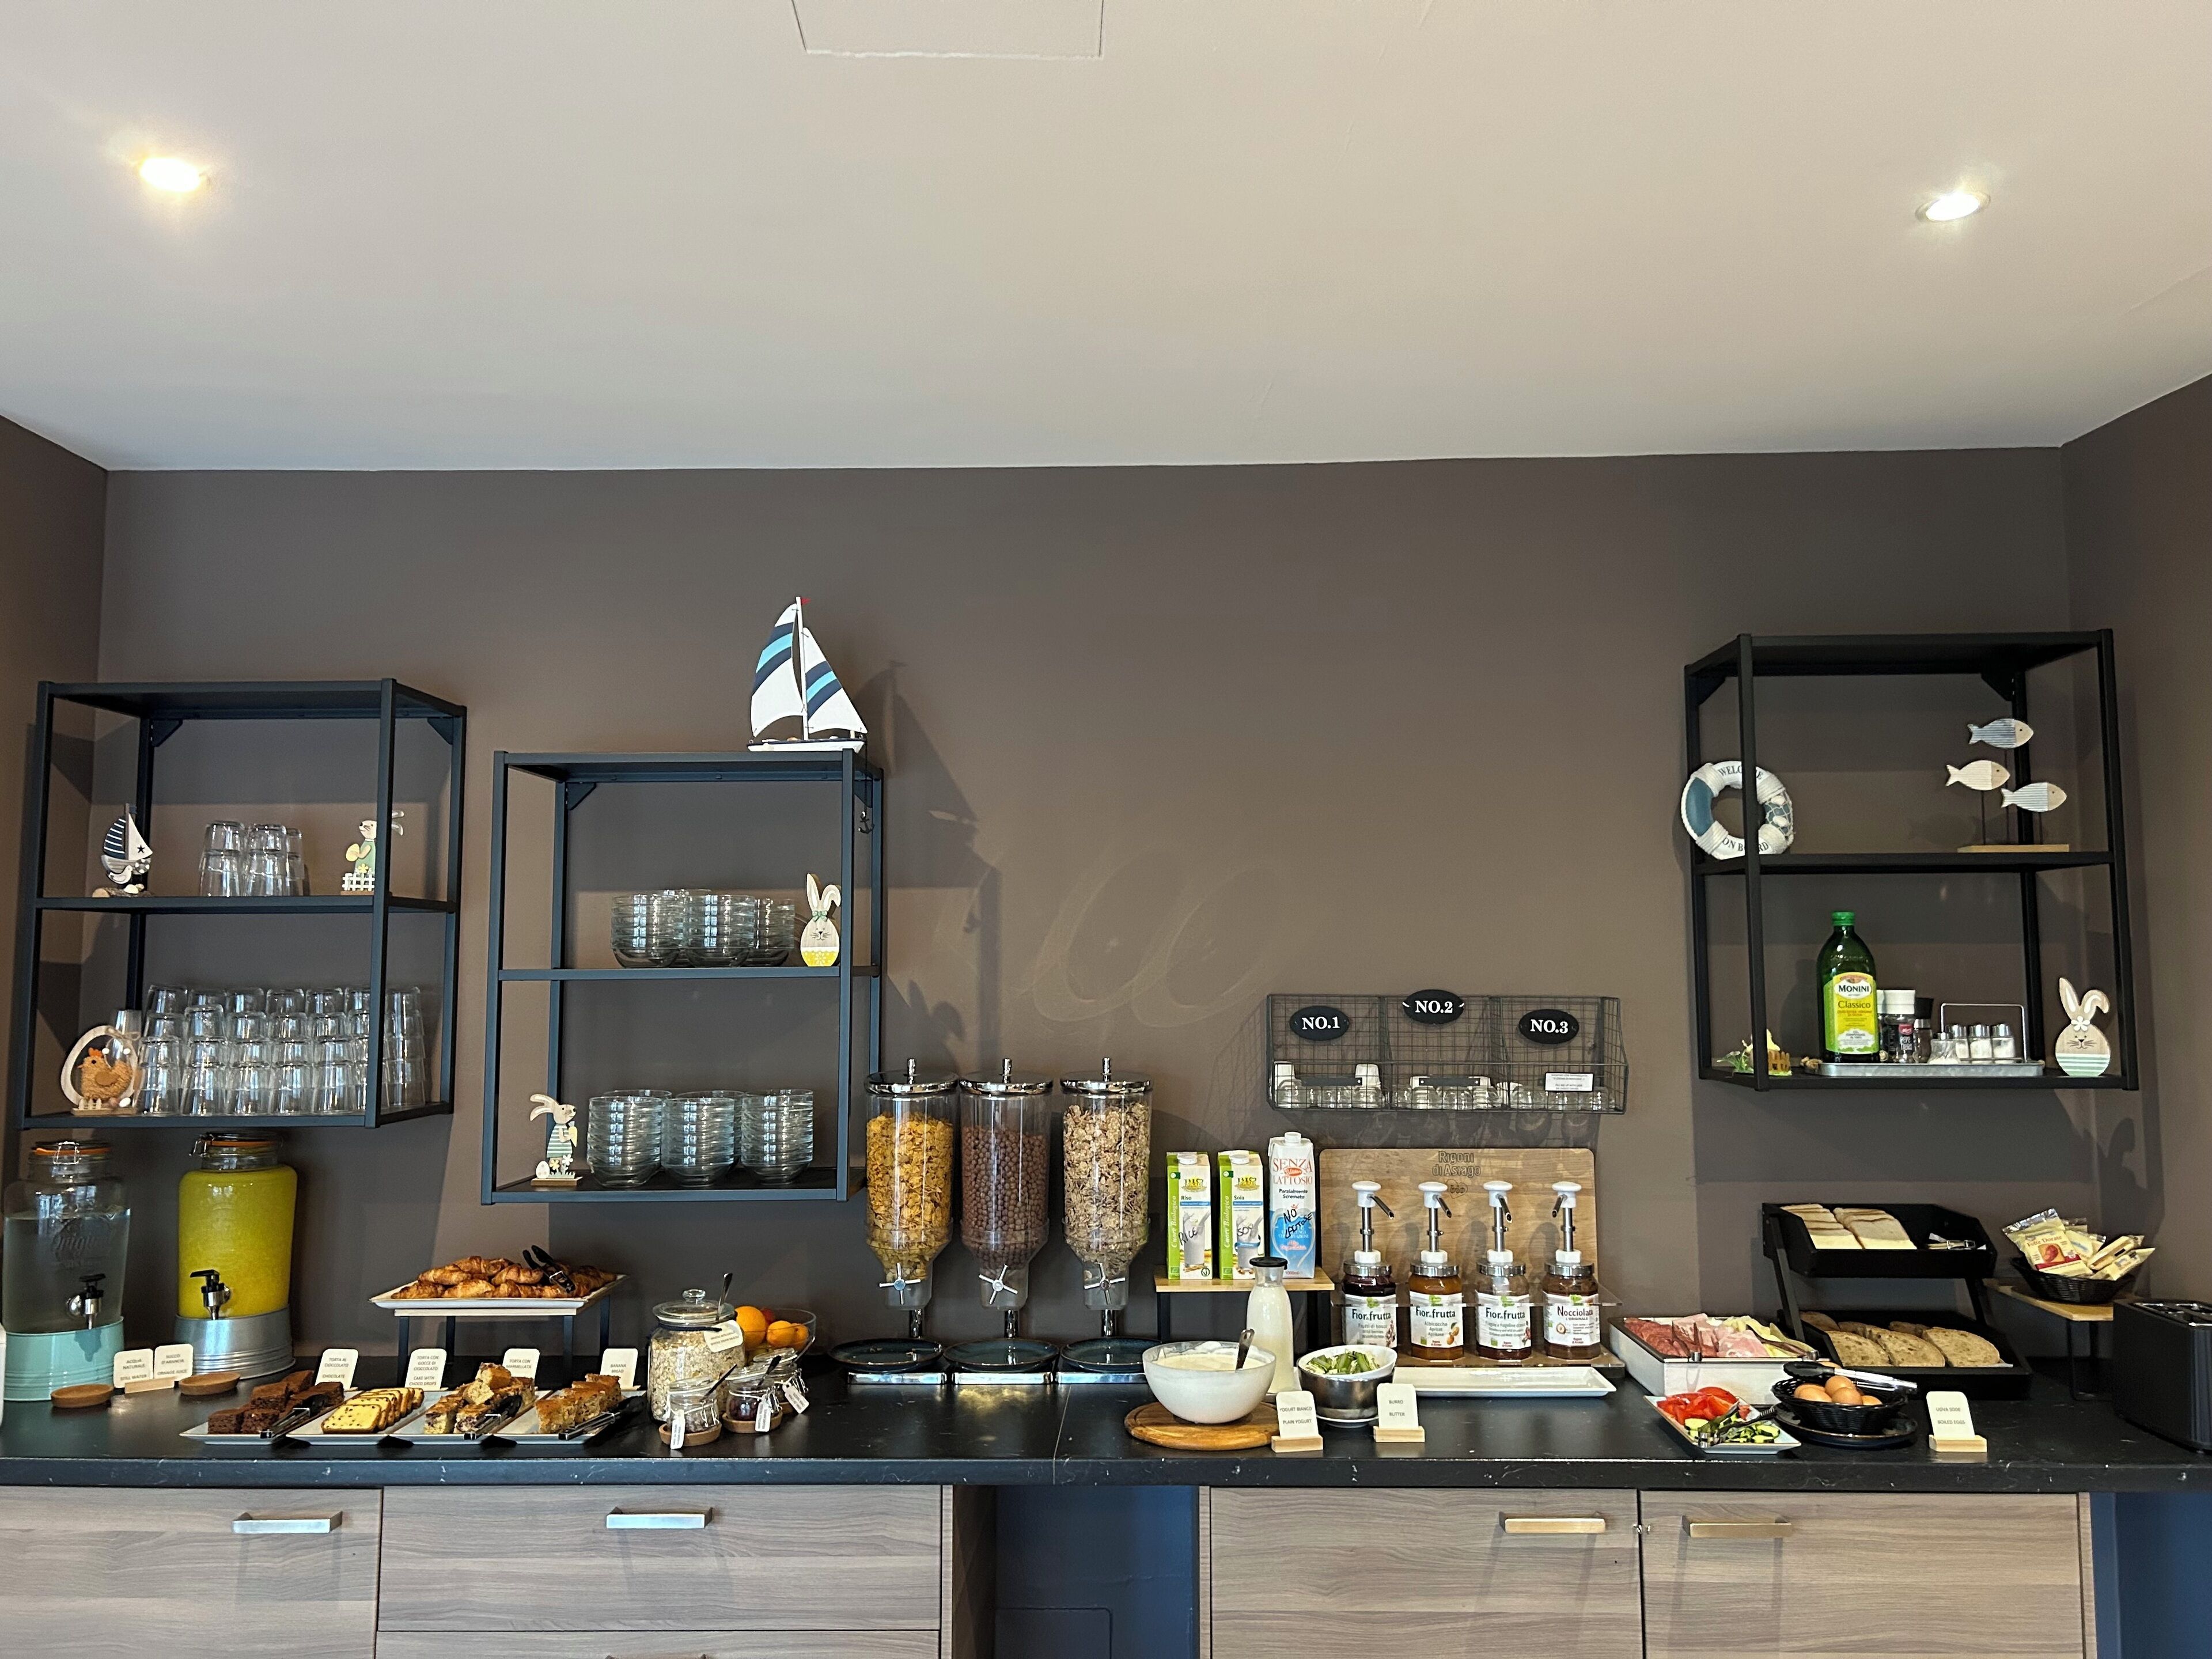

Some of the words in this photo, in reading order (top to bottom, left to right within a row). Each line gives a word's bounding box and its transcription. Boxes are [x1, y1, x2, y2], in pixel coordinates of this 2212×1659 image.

[1718, 766, 1764, 780] WELCE
[1722, 837, 1735, 849] ON
[1737, 841, 1769, 852] BRD
[1415, 1000, 1453, 1013] NO.2
[1838, 1000, 1871, 1009] Classico
[1302, 1016, 1340, 1030] NO.1
[1530, 1019, 1569, 1033] NO.3
[1438, 1150, 1474, 1164] Rigoni
[1273, 1158, 1313, 1172] SENZA
[1432, 1164, 1443, 1176] di
[1444, 1164, 1482, 1178] Asiago
[1273, 1176, 1313, 1185] LATTOSIO
[1283, 1209, 1297, 1224] NO
[1179, 1227, 1198, 1245] RICE
[1237, 1224, 1253, 1237] SOY
[1352, 1309, 1366, 1320] Fior
[1369, 1311, 1391, 1320] frutta
[1416, 1306, 1430, 1317] Fior
[1432, 1309, 1456, 1318] frutta
[1486, 1307, 1501, 1319] Fior
[1503, 1310, 1525, 1320] frutta
[1557, 1306, 1593, 1316] Nocciolata
